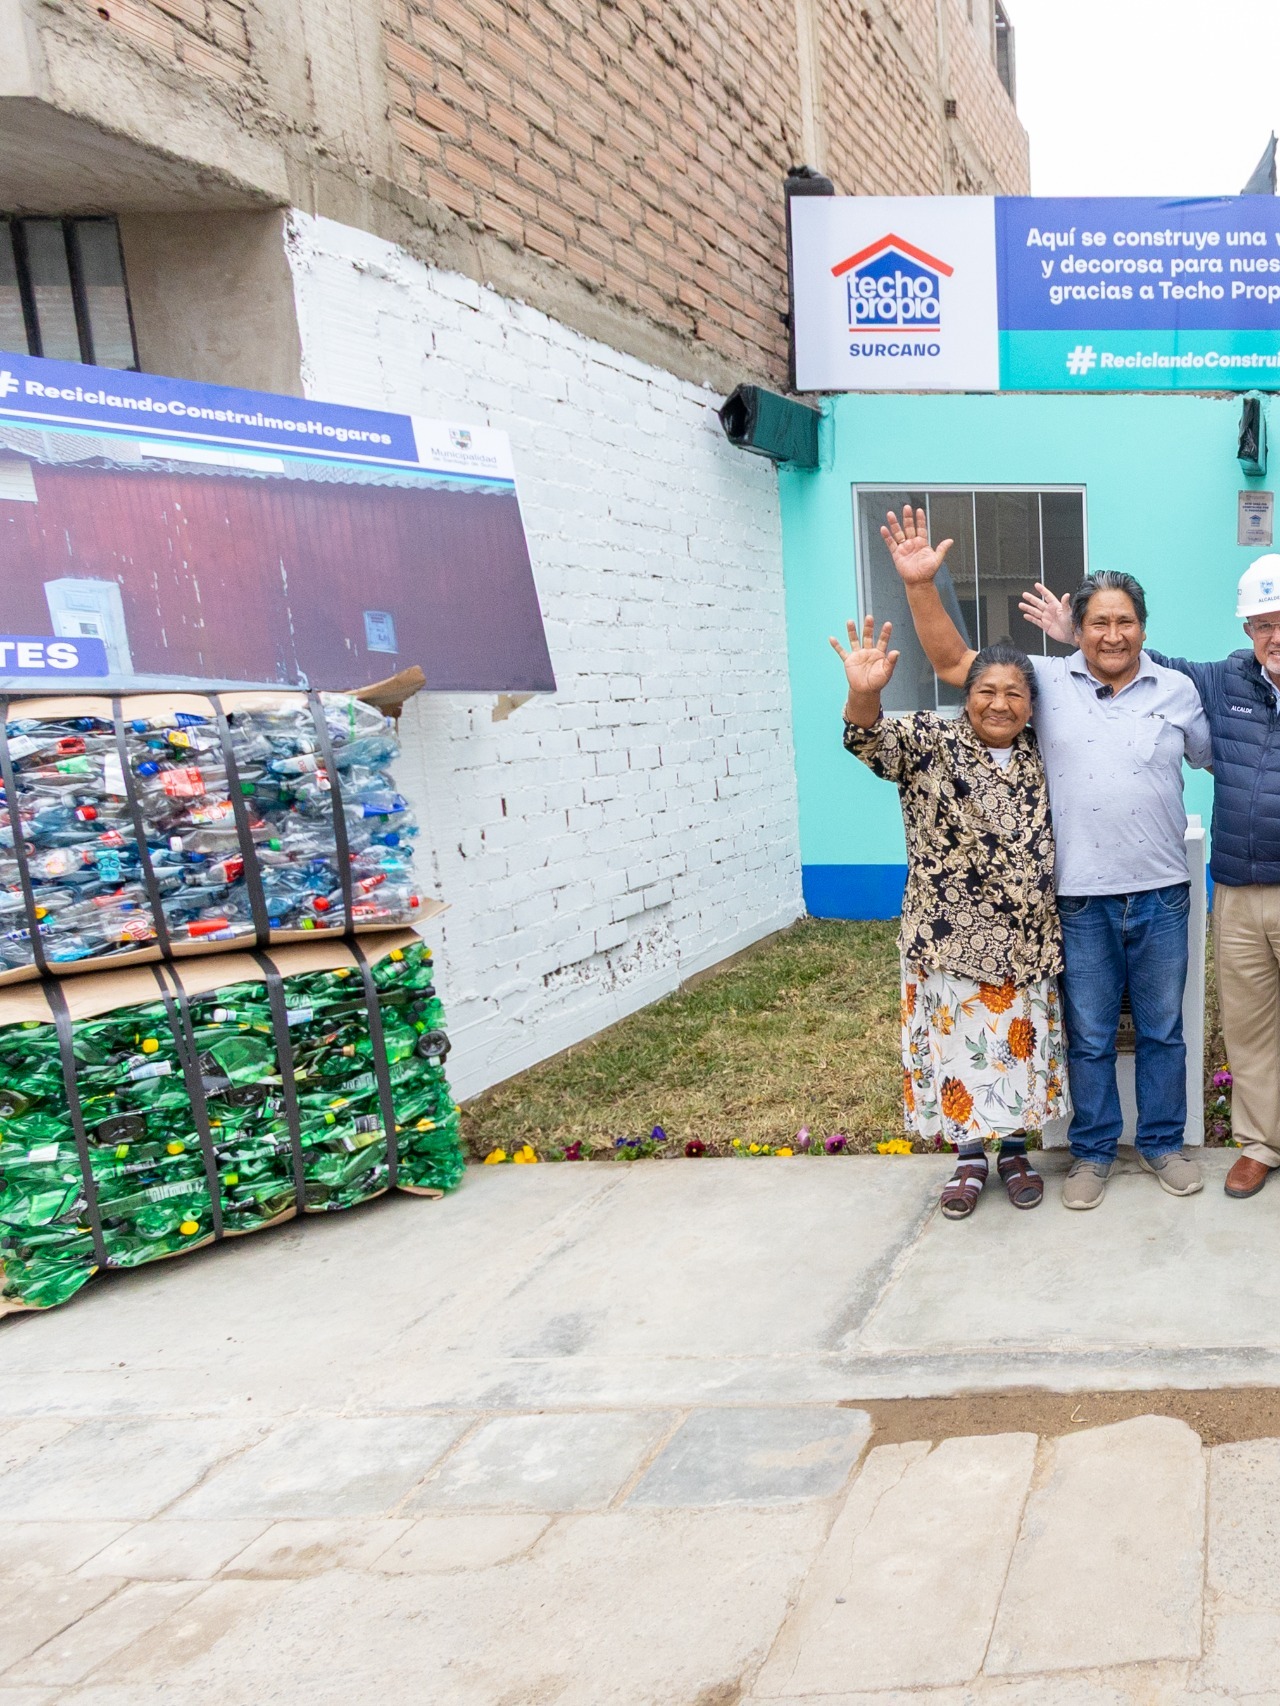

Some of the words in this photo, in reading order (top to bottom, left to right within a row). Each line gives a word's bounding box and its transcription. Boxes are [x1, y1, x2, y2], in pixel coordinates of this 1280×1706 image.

[1026, 227, 1076, 252] Aquí
[1081, 231, 1107, 246] se
[1113, 229, 1220, 251] construye
[1226, 231, 1267, 246] una
[1041, 259, 1054, 279] y
[1060, 254, 1163, 273] decorosa
[1171, 258, 1223, 277] para
[847, 270, 934, 298] techo
[1049, 281, 1133, 305] gracias
[1139, 284, 1154, 299] a
[1159, 281, 1225, 299] Techo
[850, 297, 940, 324] propio
[849, 343, 941, 357] SURCANO
[1258, 595, 1280, 603] ALCALDE
[1230, 705, 1253, 714] ALCALDE
